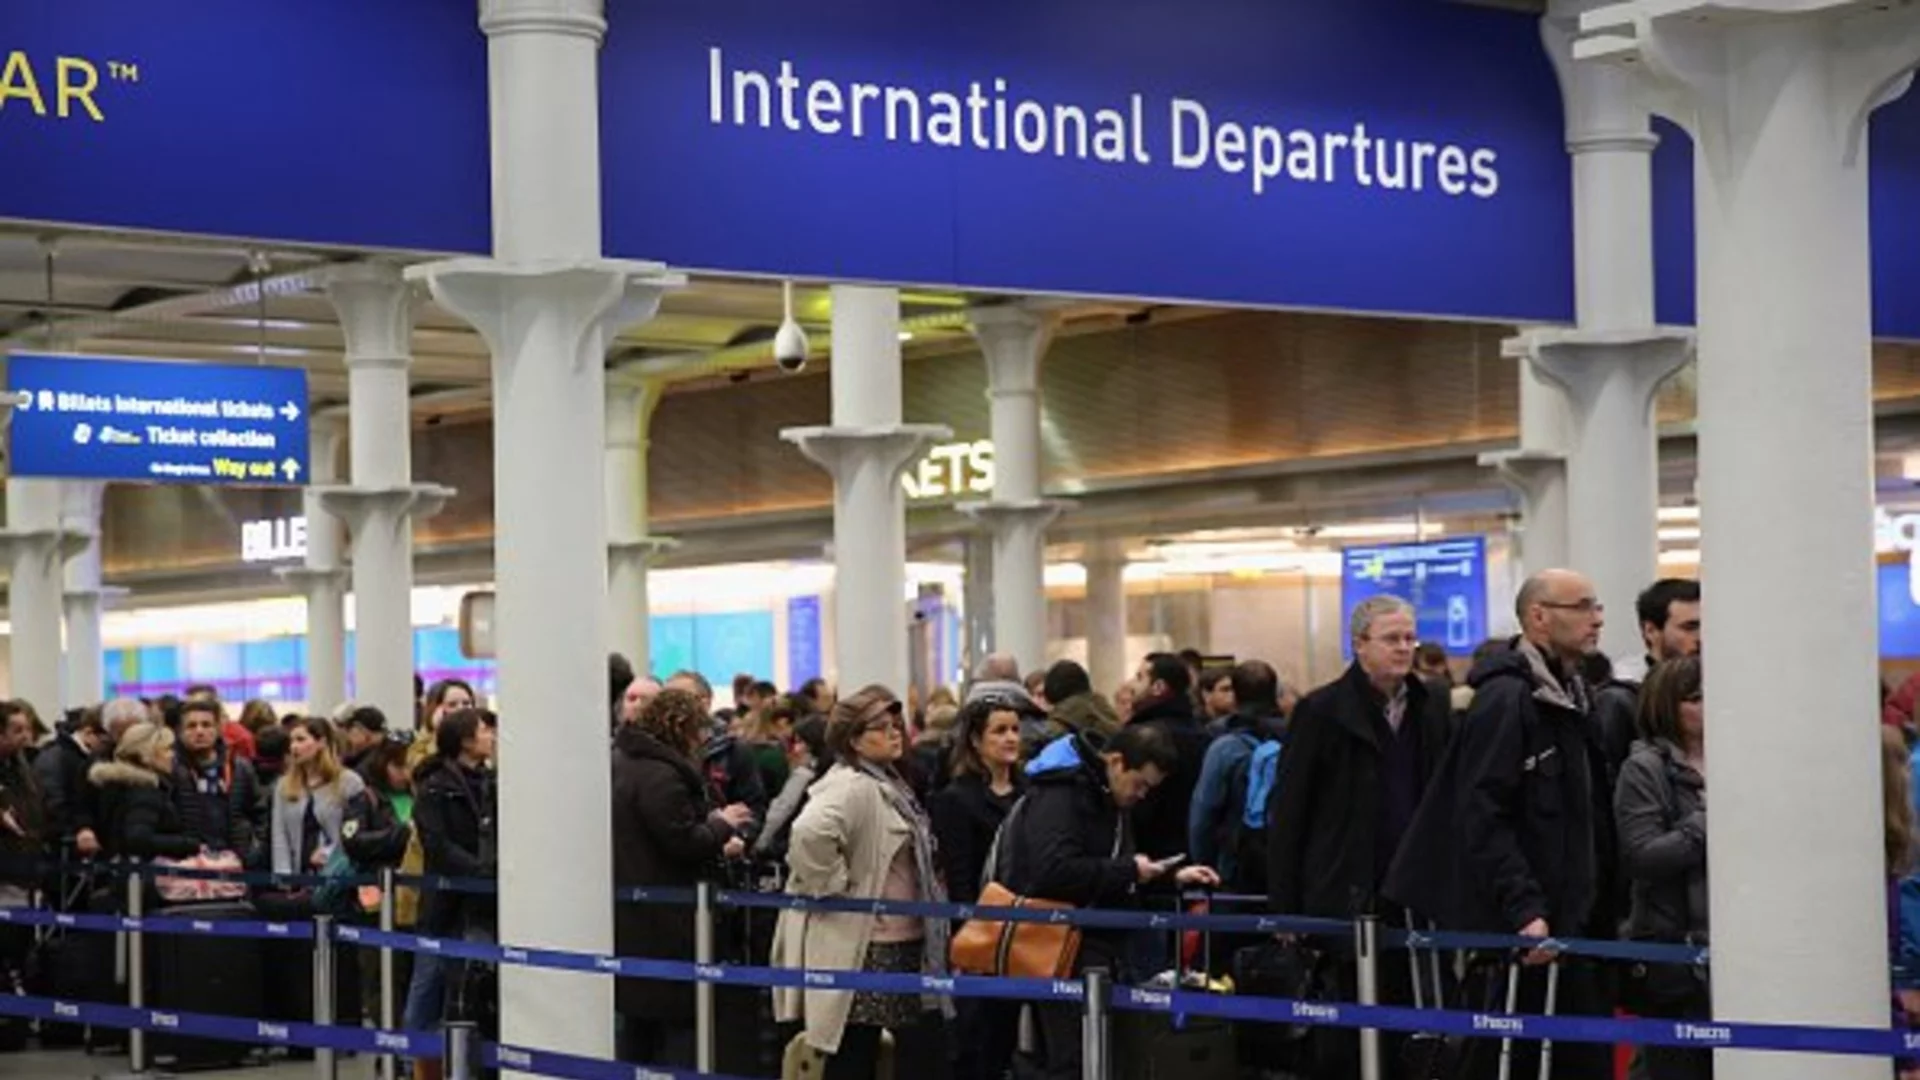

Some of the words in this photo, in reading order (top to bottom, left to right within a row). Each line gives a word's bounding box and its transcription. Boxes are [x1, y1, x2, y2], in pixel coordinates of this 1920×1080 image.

[709, 47, 1150, 164] International
[1171, 99, 1499, 197] Departures
[146, 425, 197, 446] Ticket
[199, 429, 276, 449] collection
[212, 457, 247, 480] Way
[248, 460, 276, 477] out
